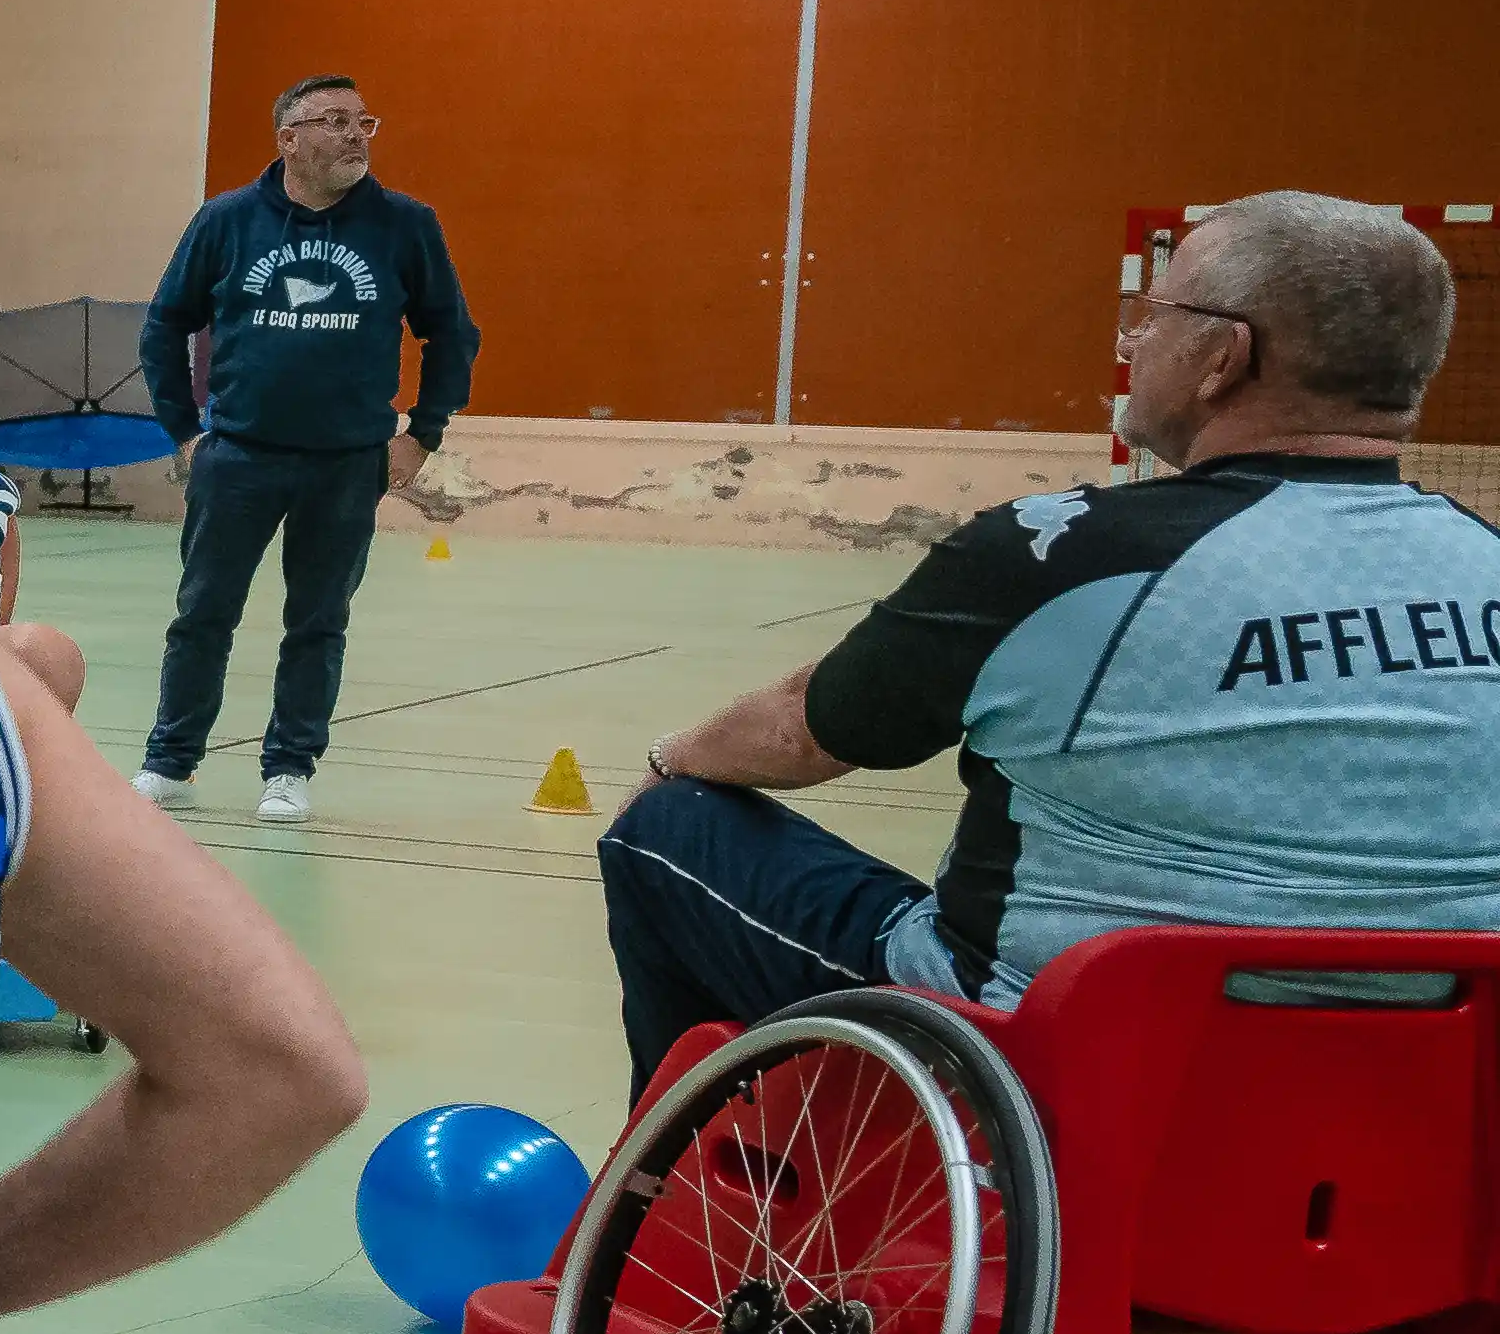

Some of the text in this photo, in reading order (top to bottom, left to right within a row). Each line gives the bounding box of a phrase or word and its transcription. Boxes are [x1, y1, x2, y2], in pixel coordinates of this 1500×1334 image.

[243, 239, 378, 302] AVIRON BAYONNAIS
[253, 309, 360, 330] LE COQ SPORTIF
